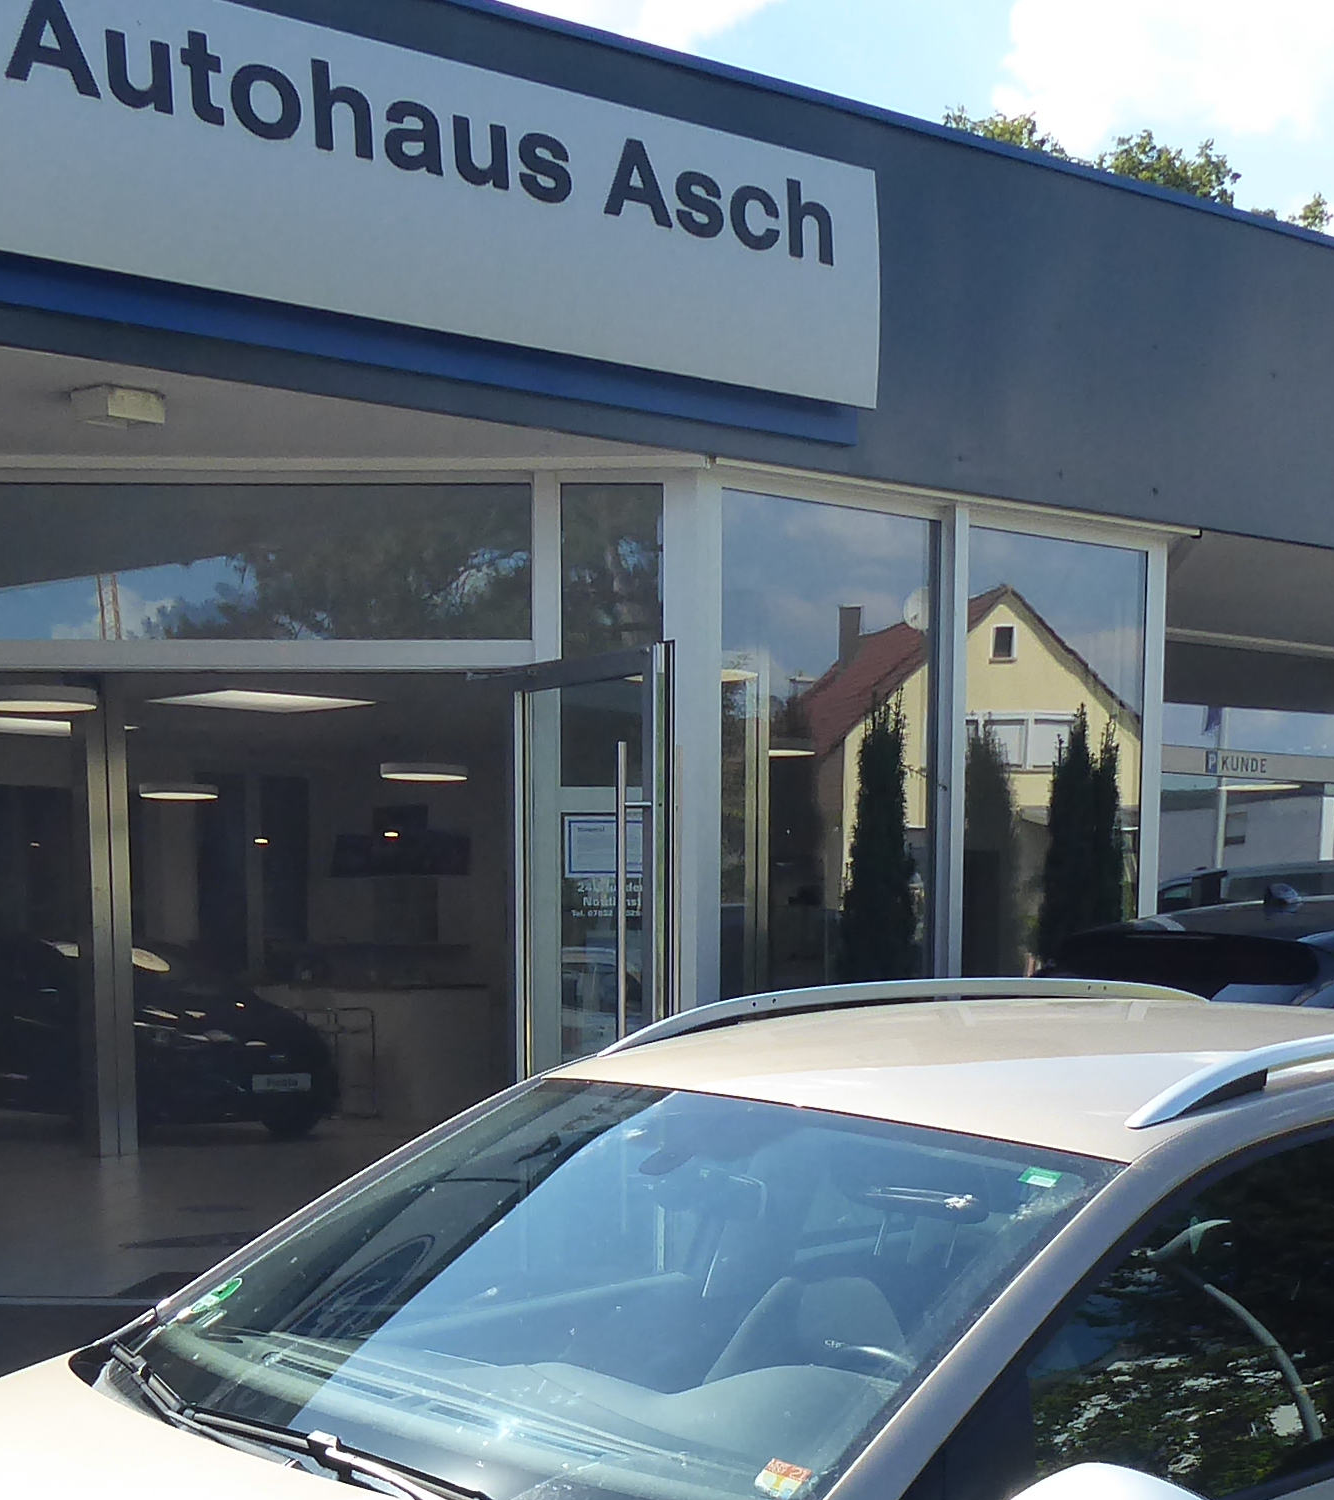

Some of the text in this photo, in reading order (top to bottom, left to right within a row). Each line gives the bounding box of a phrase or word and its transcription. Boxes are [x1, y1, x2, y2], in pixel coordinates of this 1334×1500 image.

[5, 0, 836, 267] Autohaus Asch
[1221, 755, 1268, 773] KUNDE
